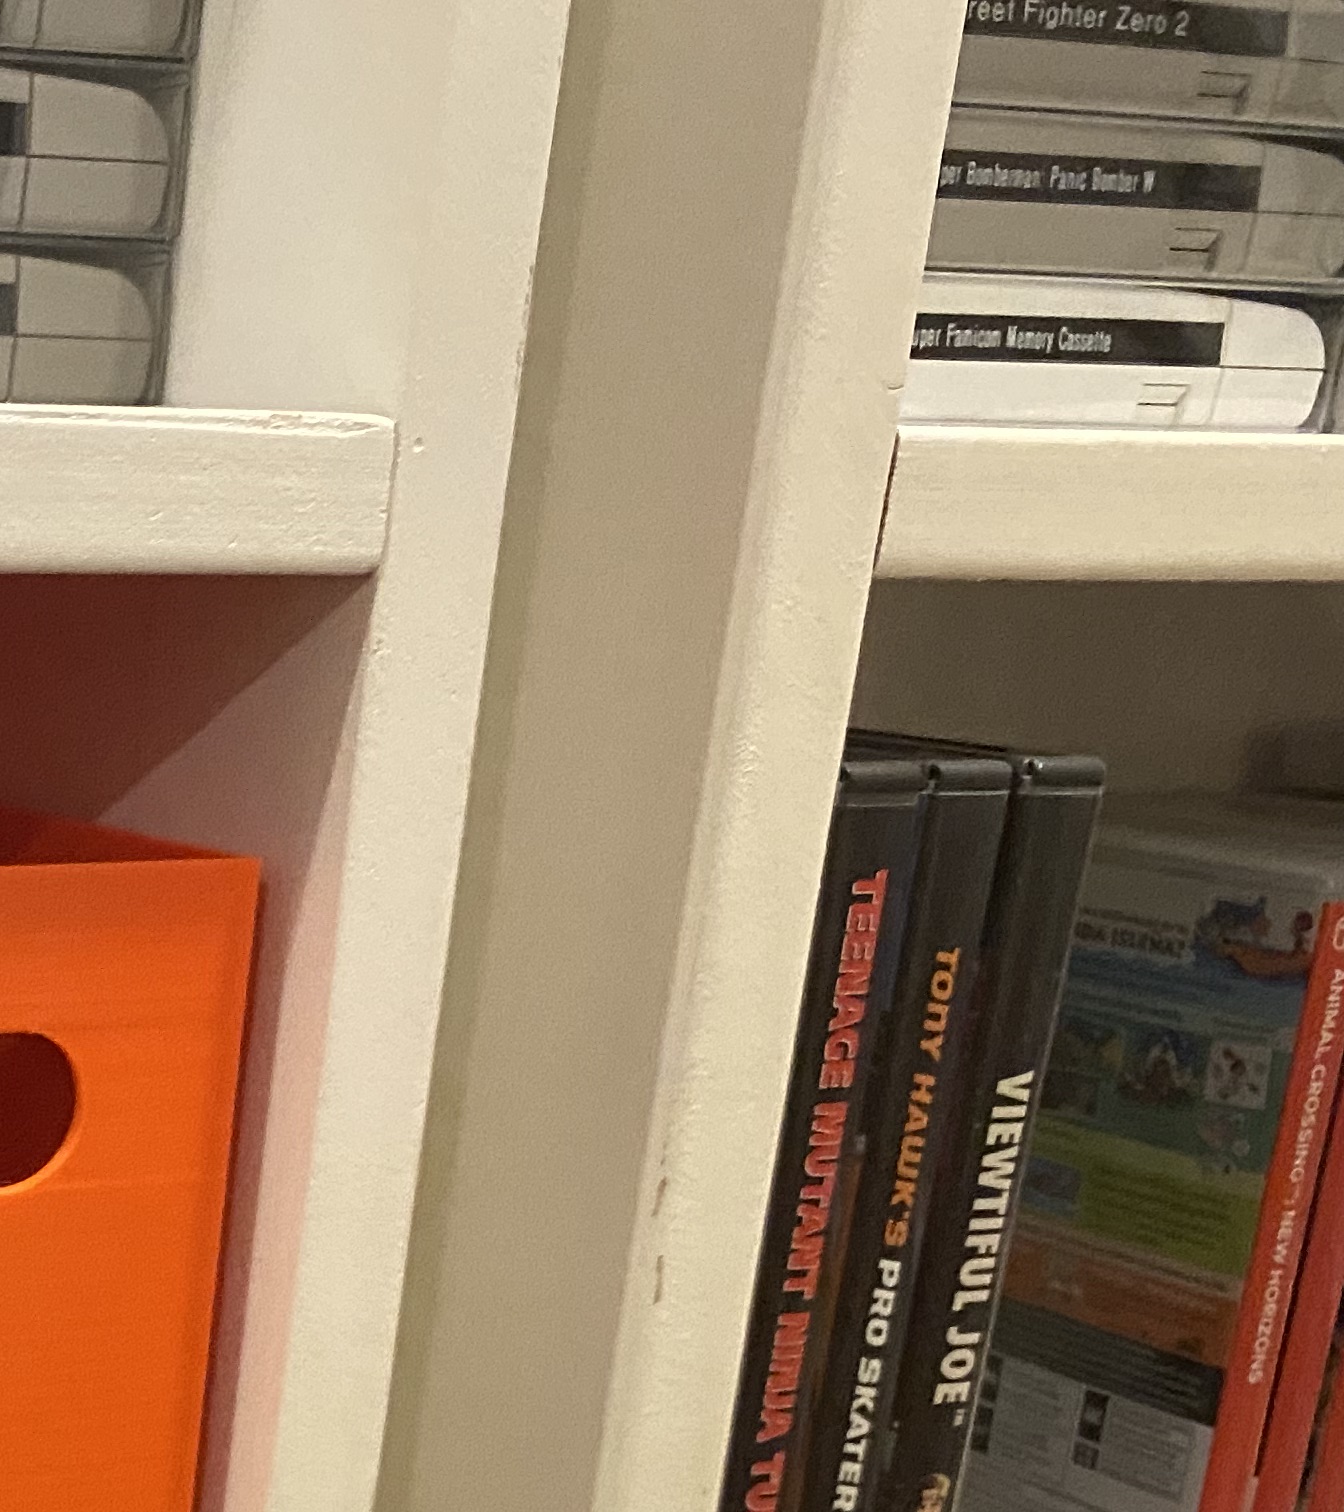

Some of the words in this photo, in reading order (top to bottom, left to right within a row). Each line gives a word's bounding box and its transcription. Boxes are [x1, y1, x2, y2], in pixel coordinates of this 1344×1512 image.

[1023, 0, 1107, 30] Fighter
[1115, 6, 1168, 34] Zero
[1175, 11, 1190, 37] 2
[1050, 165, 1087, 192] Panic
[946, 322, 1002, 347] Famicom
[1006, 325, 1055, 354] Memory
[1059, 326, 1112, 353] Cassette
[818, 868, 890, 1091] TEENAGE
[920, 946, 962, 1062] TONY
[1314, 968, 1344, 1060] ANIMAL
[783, 1100, 850, 1301] MUTANT
[884, 1072, 936, 1249] HAWK'S
[952, 1070, 1036, 1312] VIEWTIFUL
[865, 1259, 902, 1347] PRO
[755, 1311, 811, 1443] NINJA
[934, 1324, 986, 1407] JOE
